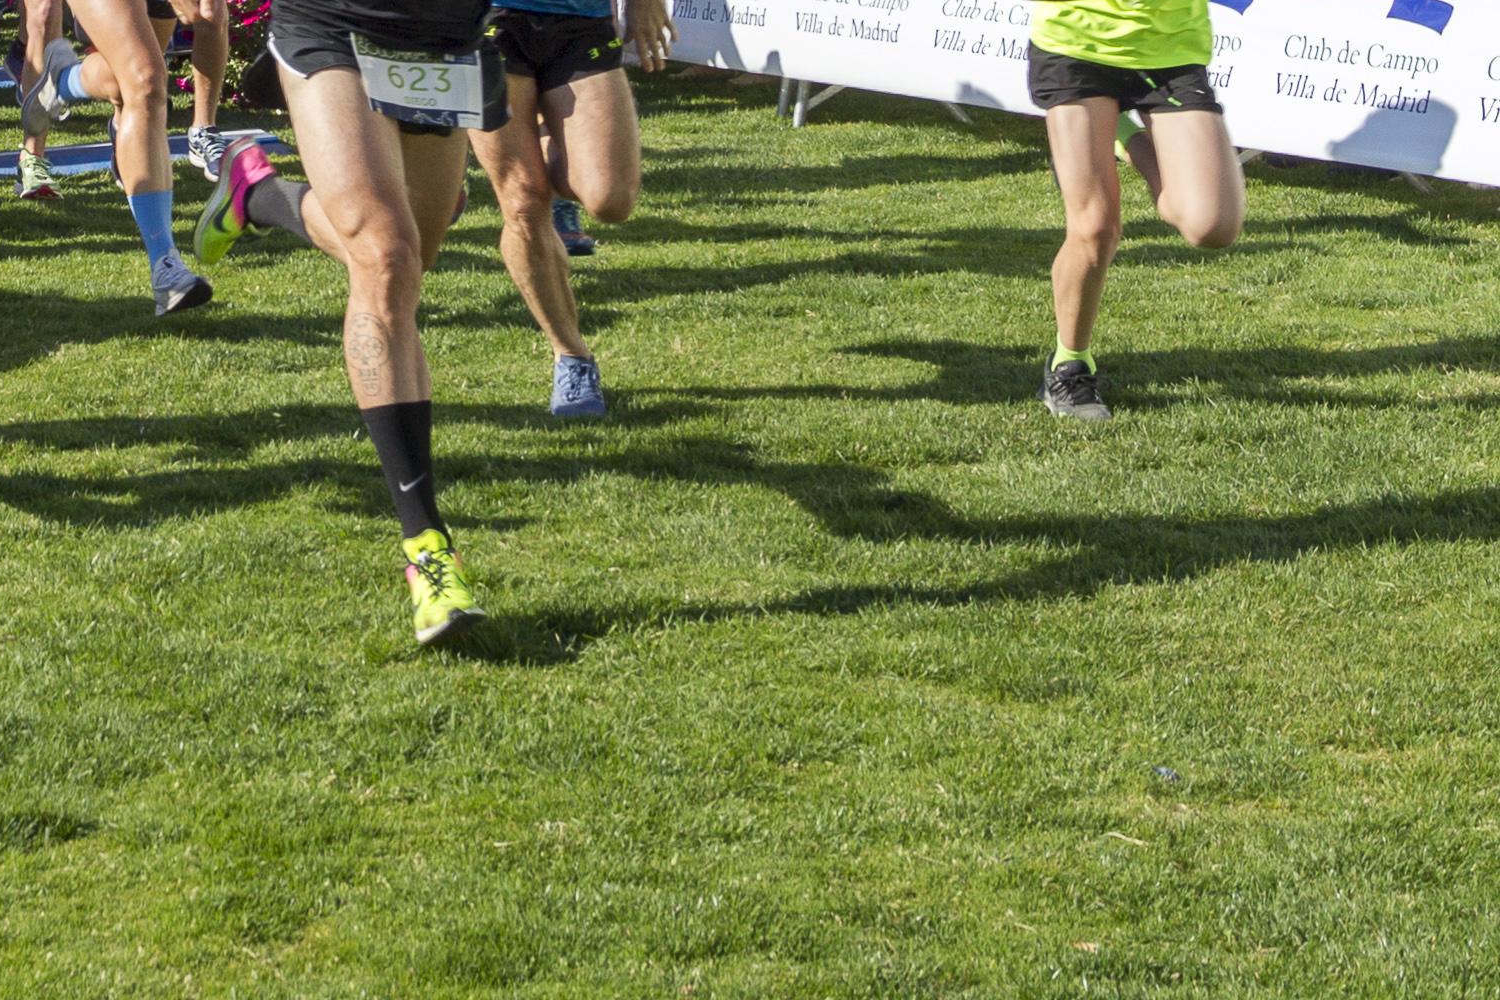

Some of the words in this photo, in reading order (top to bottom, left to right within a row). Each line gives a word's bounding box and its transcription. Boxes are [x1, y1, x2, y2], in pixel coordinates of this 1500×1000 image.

[702, 1, 716, 21] de
[719, 2, 767, 27] Madrid
[984, 1, 1003, 23] de
[795, 11, 823, 35] Villa
[828, 13, 845, 37] de
[848, 19, 900, 44] Madrid
[932, 29, 966, 53] Villa
[971, 34, 991, 55] de
[1284, 34, 1331, 63] Club
[1337, 38, 1360, 65] de
[1366, 42, 1439, 79] Campo
[387, 64, 451, 92] 623
[1276, 72, 1315, 101] Villa
[1323, 76, 1347, 105] de
[1353, 83, 1431, 114] Madrid
